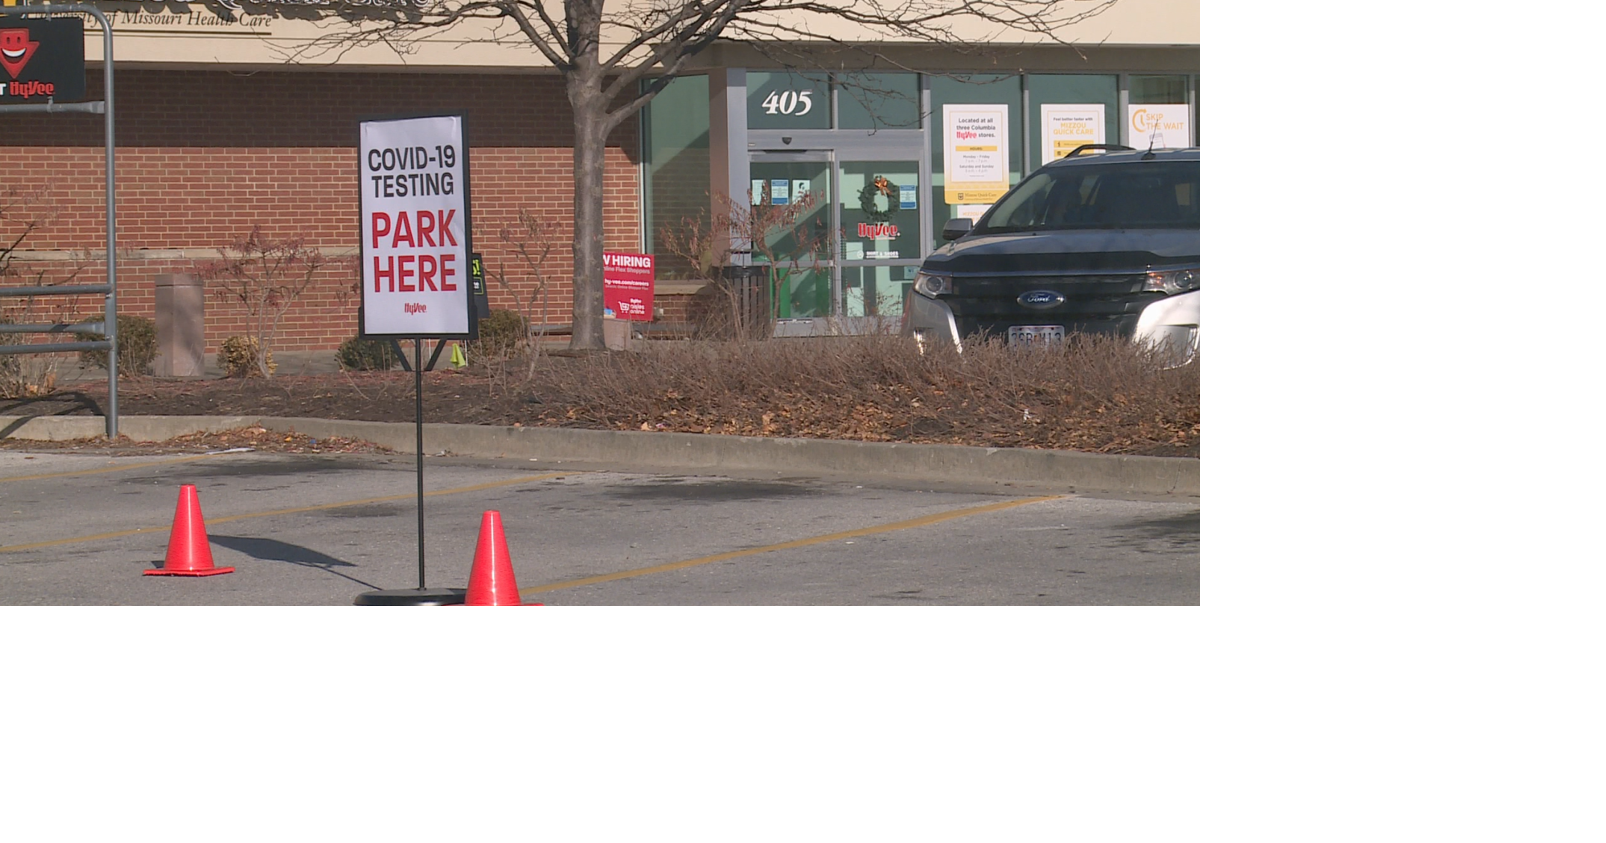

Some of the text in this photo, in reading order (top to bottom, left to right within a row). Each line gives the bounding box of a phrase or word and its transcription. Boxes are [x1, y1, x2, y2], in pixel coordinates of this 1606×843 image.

[121, 11, 183, 26] Missouri
[187, 11, 235, 26] Health
[238, 12, 272, 27] Care
[9, 80, 55, 99] HyVee
[761, 89, 813, 116] 405
[1146, 113, 1164, 121] SKIP
[1146, 122, 1184, 130] THE WAIT
[368, 144, 456, 172] COVID-19
[371, 172, 454, 198] TESTING
[371, 209, 459, 249] PARK
[612, 255, 651, 268] HIRING
[373, 254, 457, 293] HERE
[1027, 293, 1050, 303] Ford
[404, 302, 427, 315] HyVee
